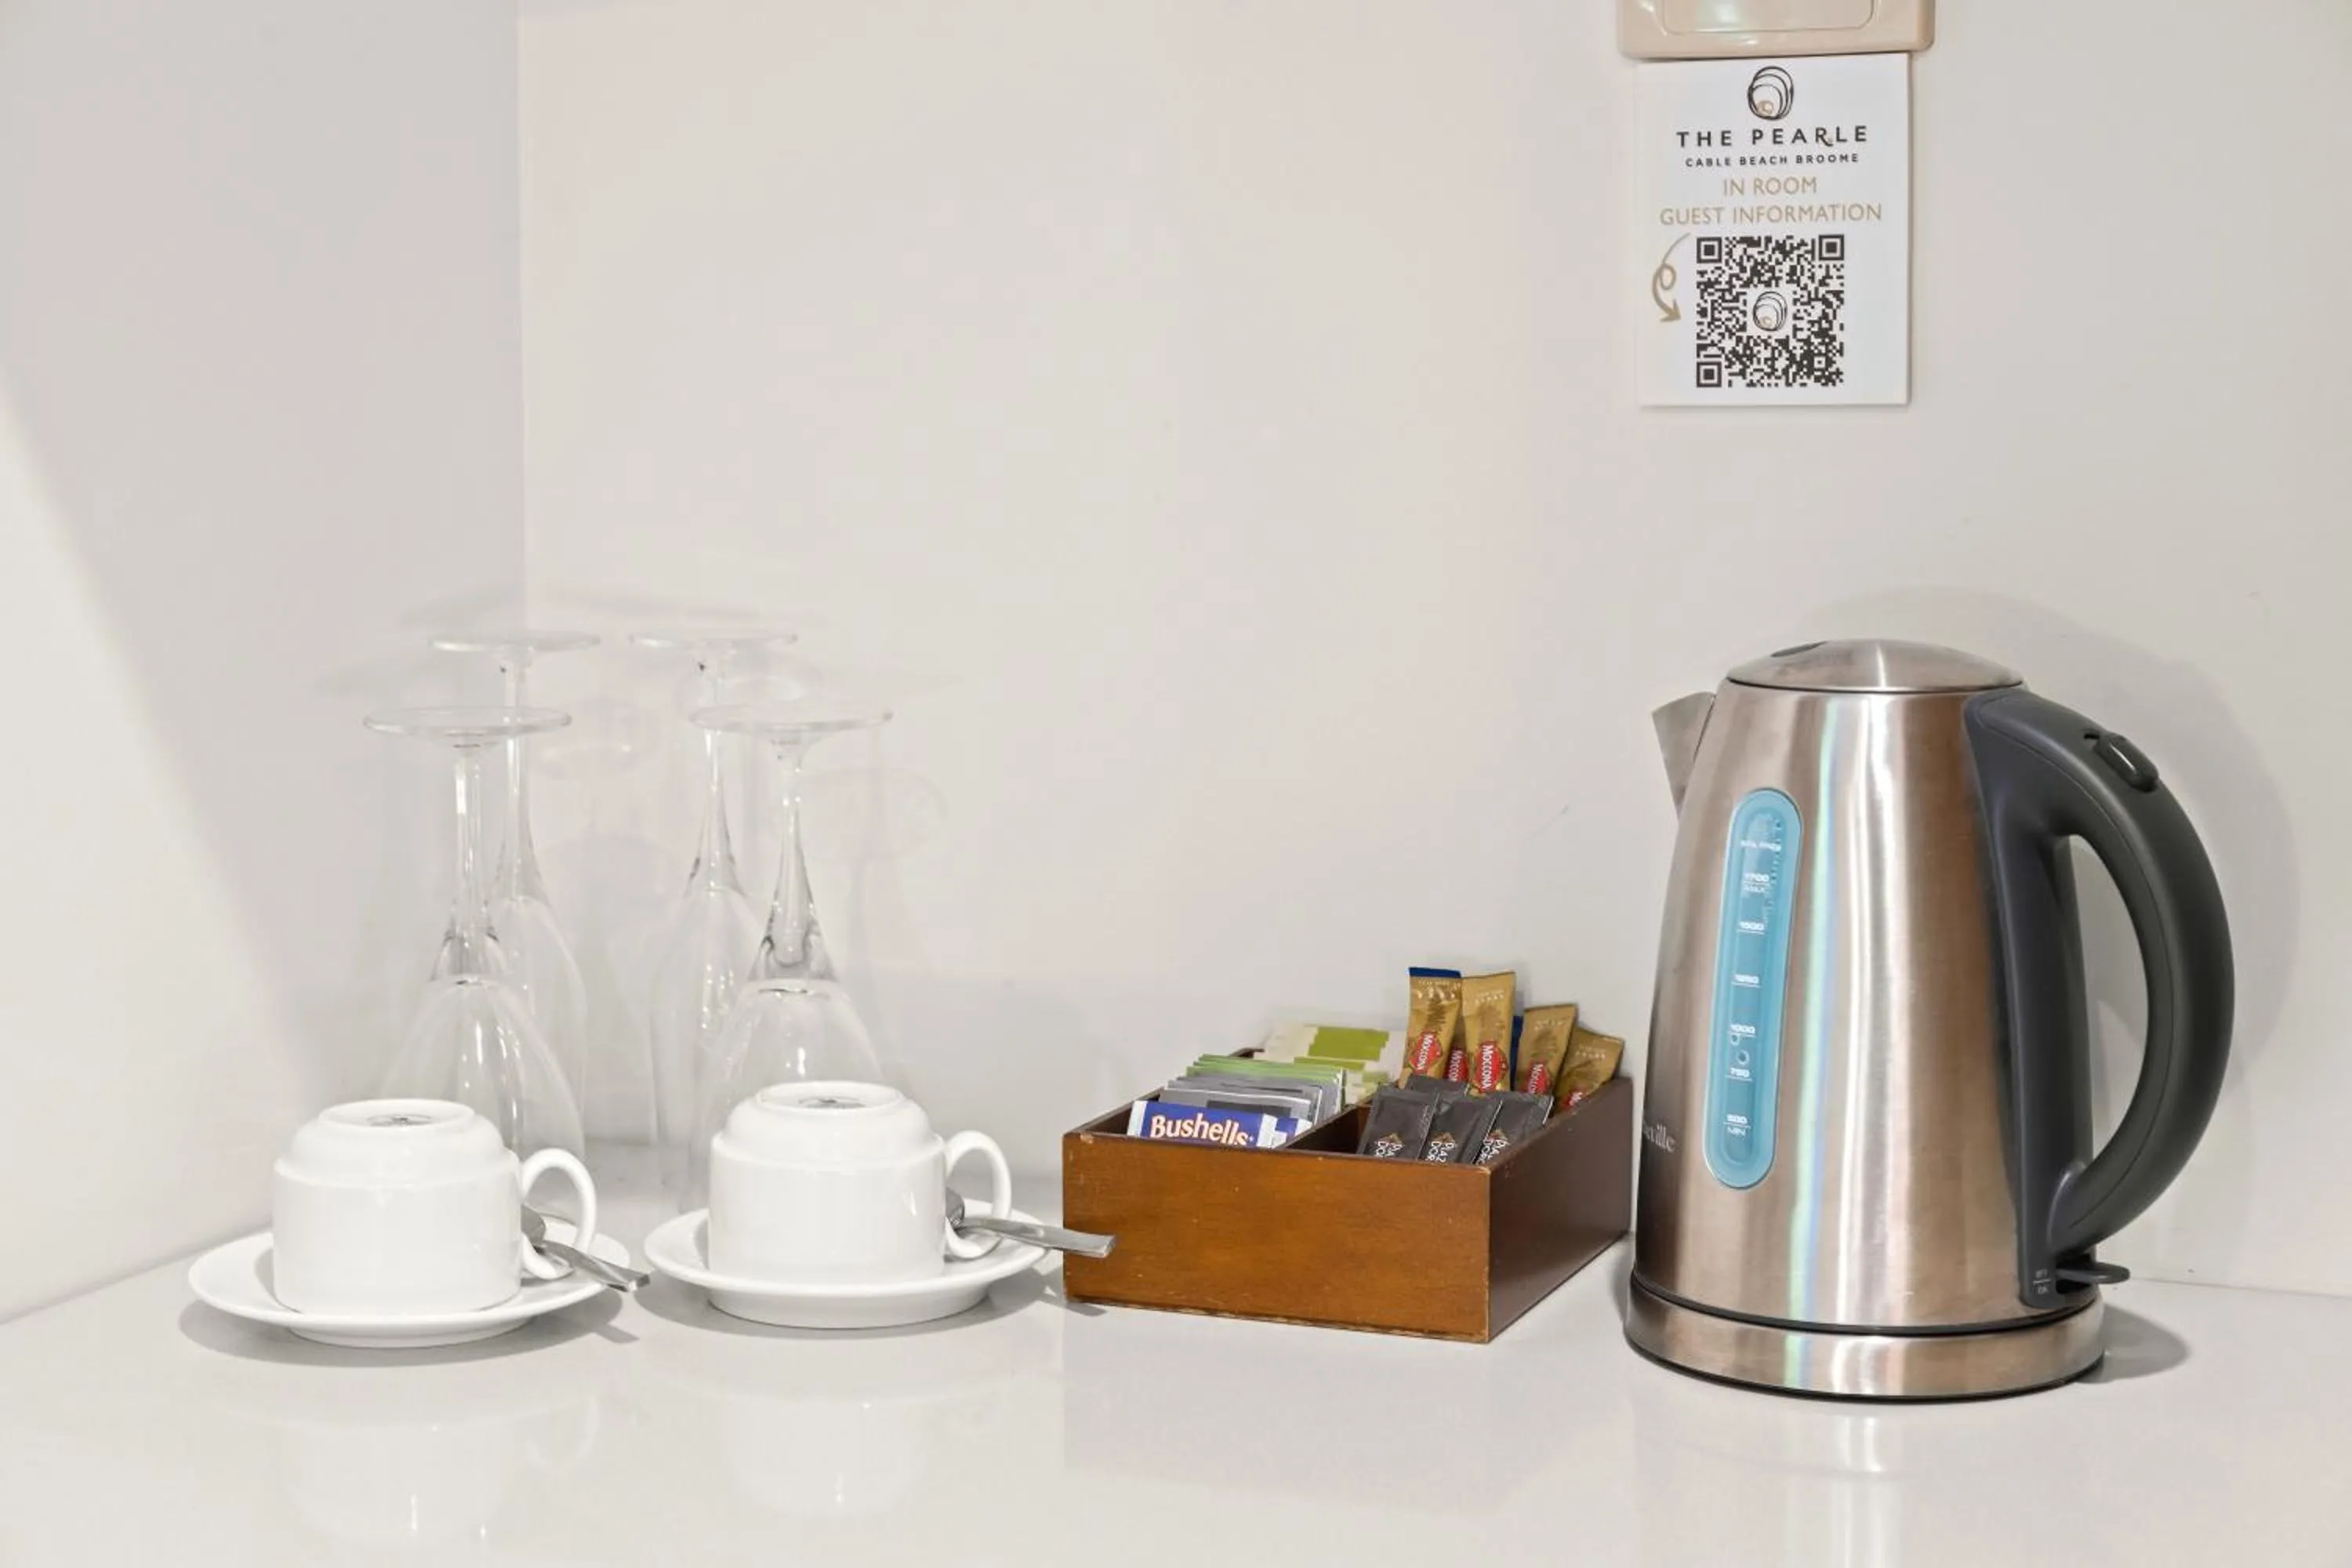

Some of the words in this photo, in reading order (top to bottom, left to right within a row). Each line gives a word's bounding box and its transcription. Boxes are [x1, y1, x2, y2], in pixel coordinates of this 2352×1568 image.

[1676, 129, 1732, 147] THE
[1751, 125, 1867, 147] PEARLE
[1686, 157, 1732, 168] CABLE
[1740, 155, 1788, 166] BEACH
[1796, 153, 1859, 165] BROOME
[1723, 178, 1745, 196] IN
[1753, 176, 1817, 195] ROOM
[1659, 206, 1725, 226] GUEST
[1733, 203, 1882, 224] INFORMATION
[1482, 1044, 1494, 1089] MOCCONA
[1149, 1112, 1249, 1145] Bushells
